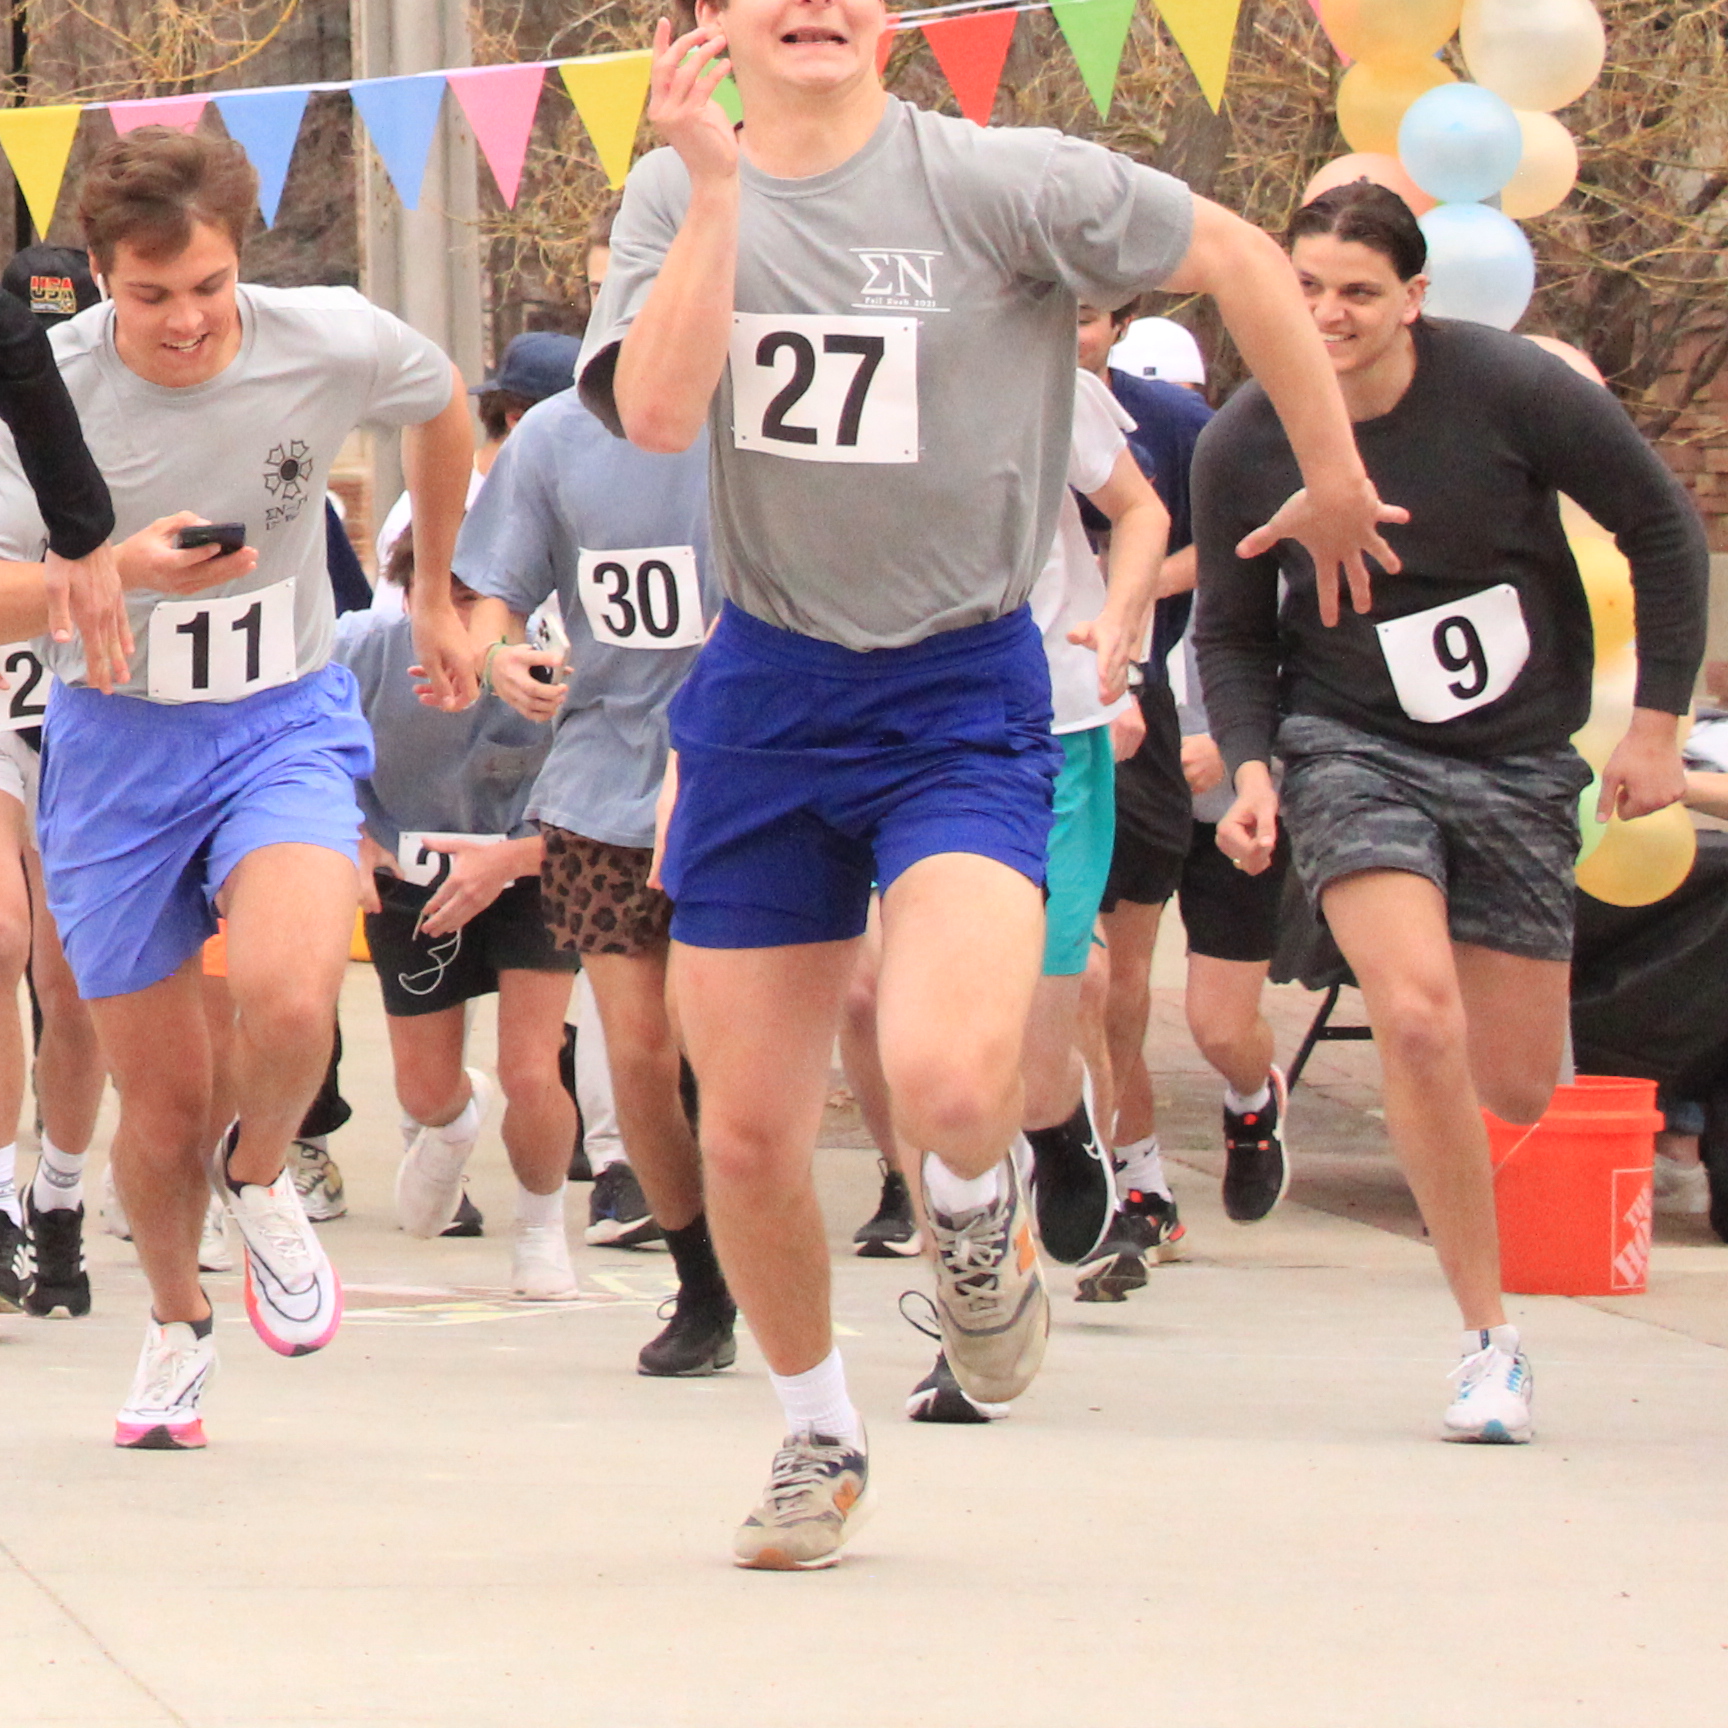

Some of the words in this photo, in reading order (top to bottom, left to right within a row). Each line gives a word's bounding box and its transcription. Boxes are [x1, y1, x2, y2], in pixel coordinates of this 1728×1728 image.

[30, 276, 75, 300] USA
[755, 331, 885, 446] 27
[593, 560, 680, 639] 30
[176, 602, 263, 689] 11
[1433, 615, 1489, 700] 9
